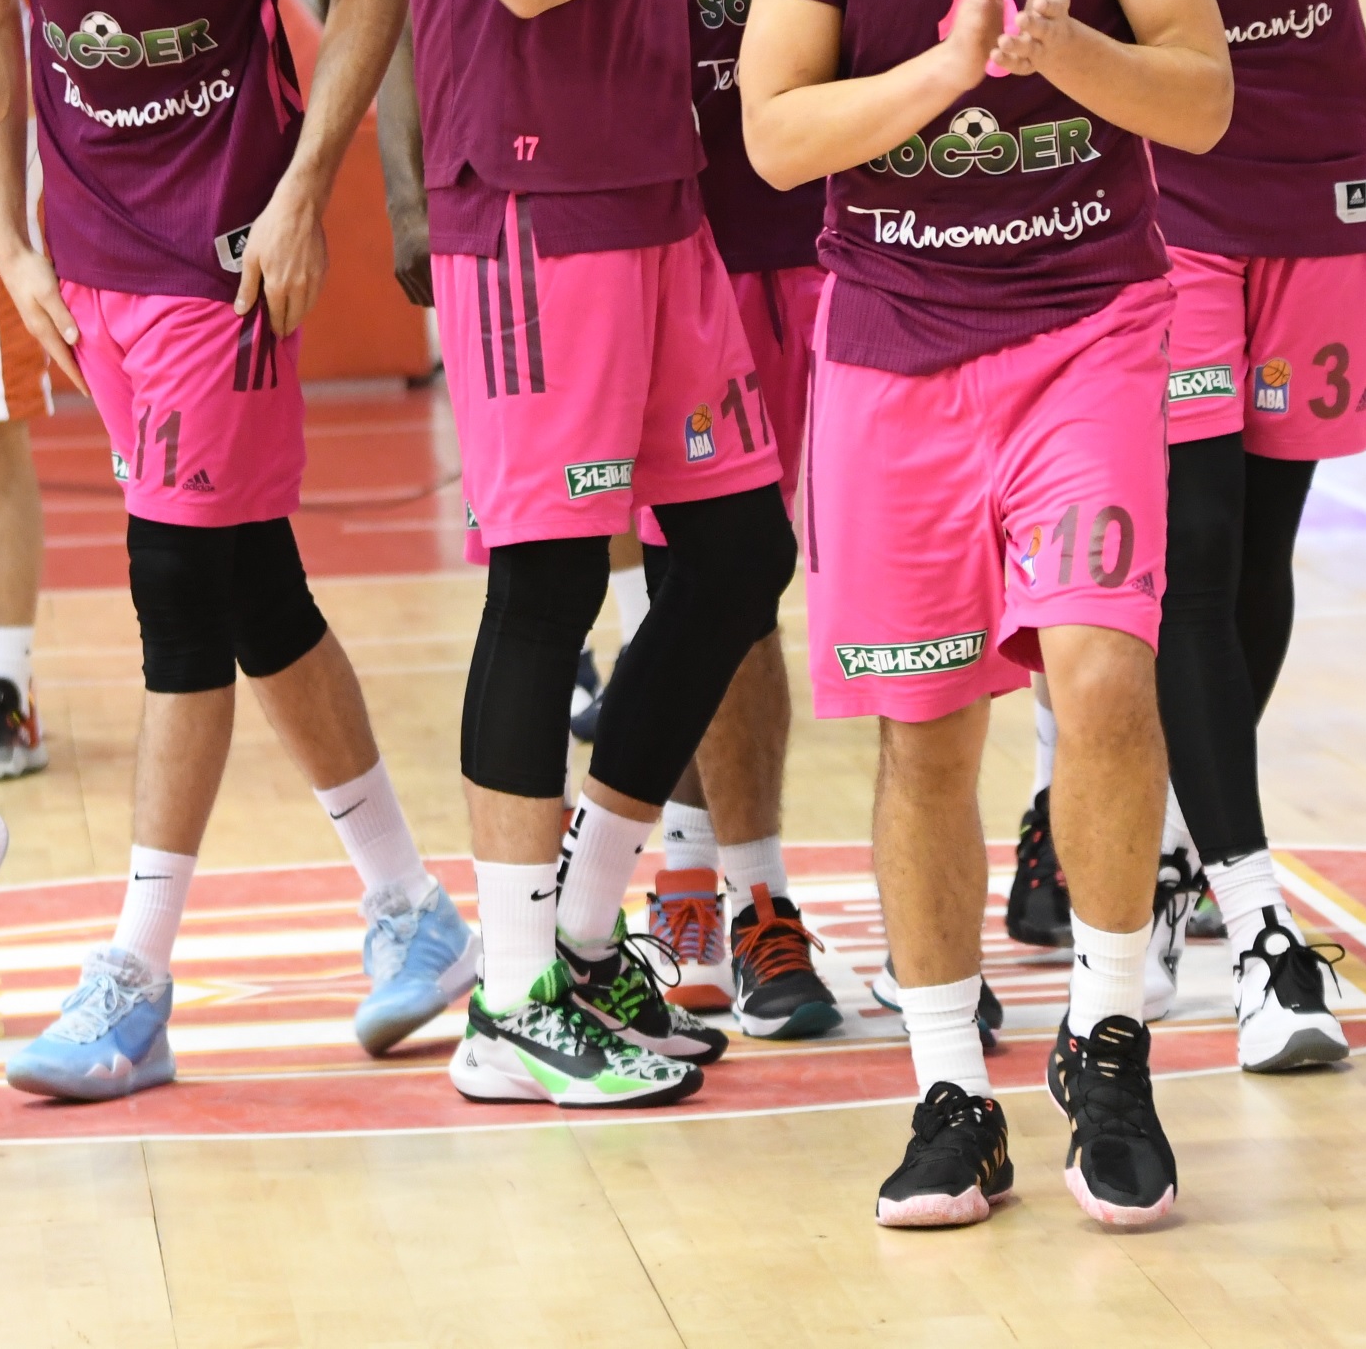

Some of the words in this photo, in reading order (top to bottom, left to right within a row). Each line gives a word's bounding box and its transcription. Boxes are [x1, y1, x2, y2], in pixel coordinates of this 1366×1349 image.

[513, 136, 540, 161] 17
[720, 370, 772, 454] 17
[1256, 388, 1285, 410] ABA
[1308, 342, 1351, 420] 3
[135, 403, 183, 489] 11
[689, 436, 715, 460] ABA
[1051, 503, 1136, 589] 10
